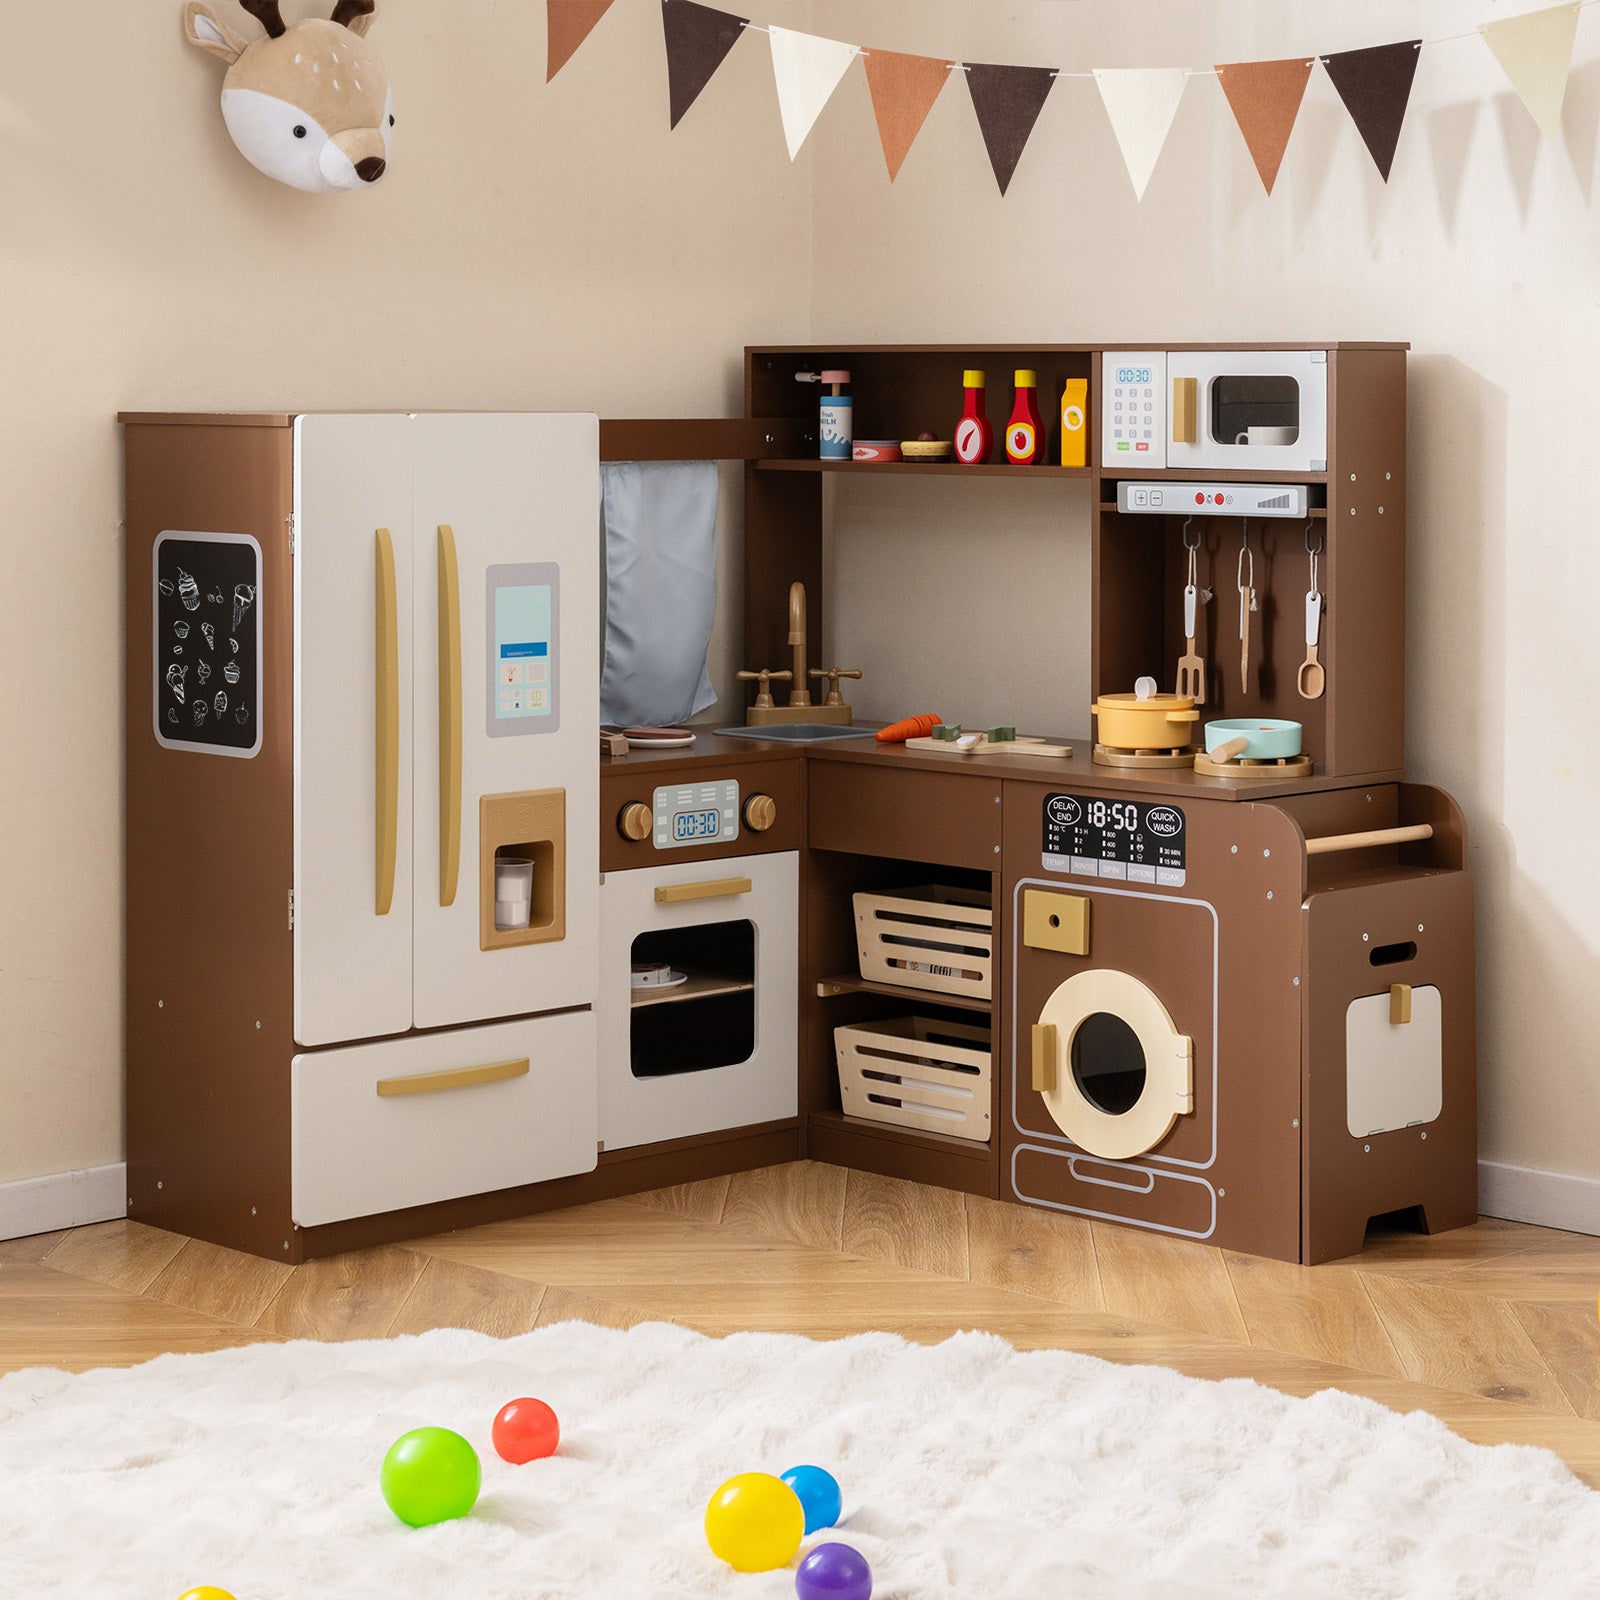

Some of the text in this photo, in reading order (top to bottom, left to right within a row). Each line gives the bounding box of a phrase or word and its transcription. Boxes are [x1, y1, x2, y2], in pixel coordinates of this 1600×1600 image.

[1119, 369, 1149, 382] 00:30
[1053, 801, 1076, 812] DELAY
[1056, 812, 1072, 821] END
[1087, 801, 1138, 832] 18:50
[1150, 811, 1176, 823] QUICK
[677, 812, 716, 837] 00:30
[1152, 822, 1176, 834] WASH
[1106, 831, 1117, 839] 800
[1106, 841, 1117, 849] 400
[1170, 849, 1182, 857] MIN
[1045, 857, 1066, 867] TEMP
[1073, 860, 1096, 872] RINSE
[1170, 859, 1182, 867] MIN
[1102, 864, 1120, 875] SPIN
[1159, 871, 1181, 882] SOAK
